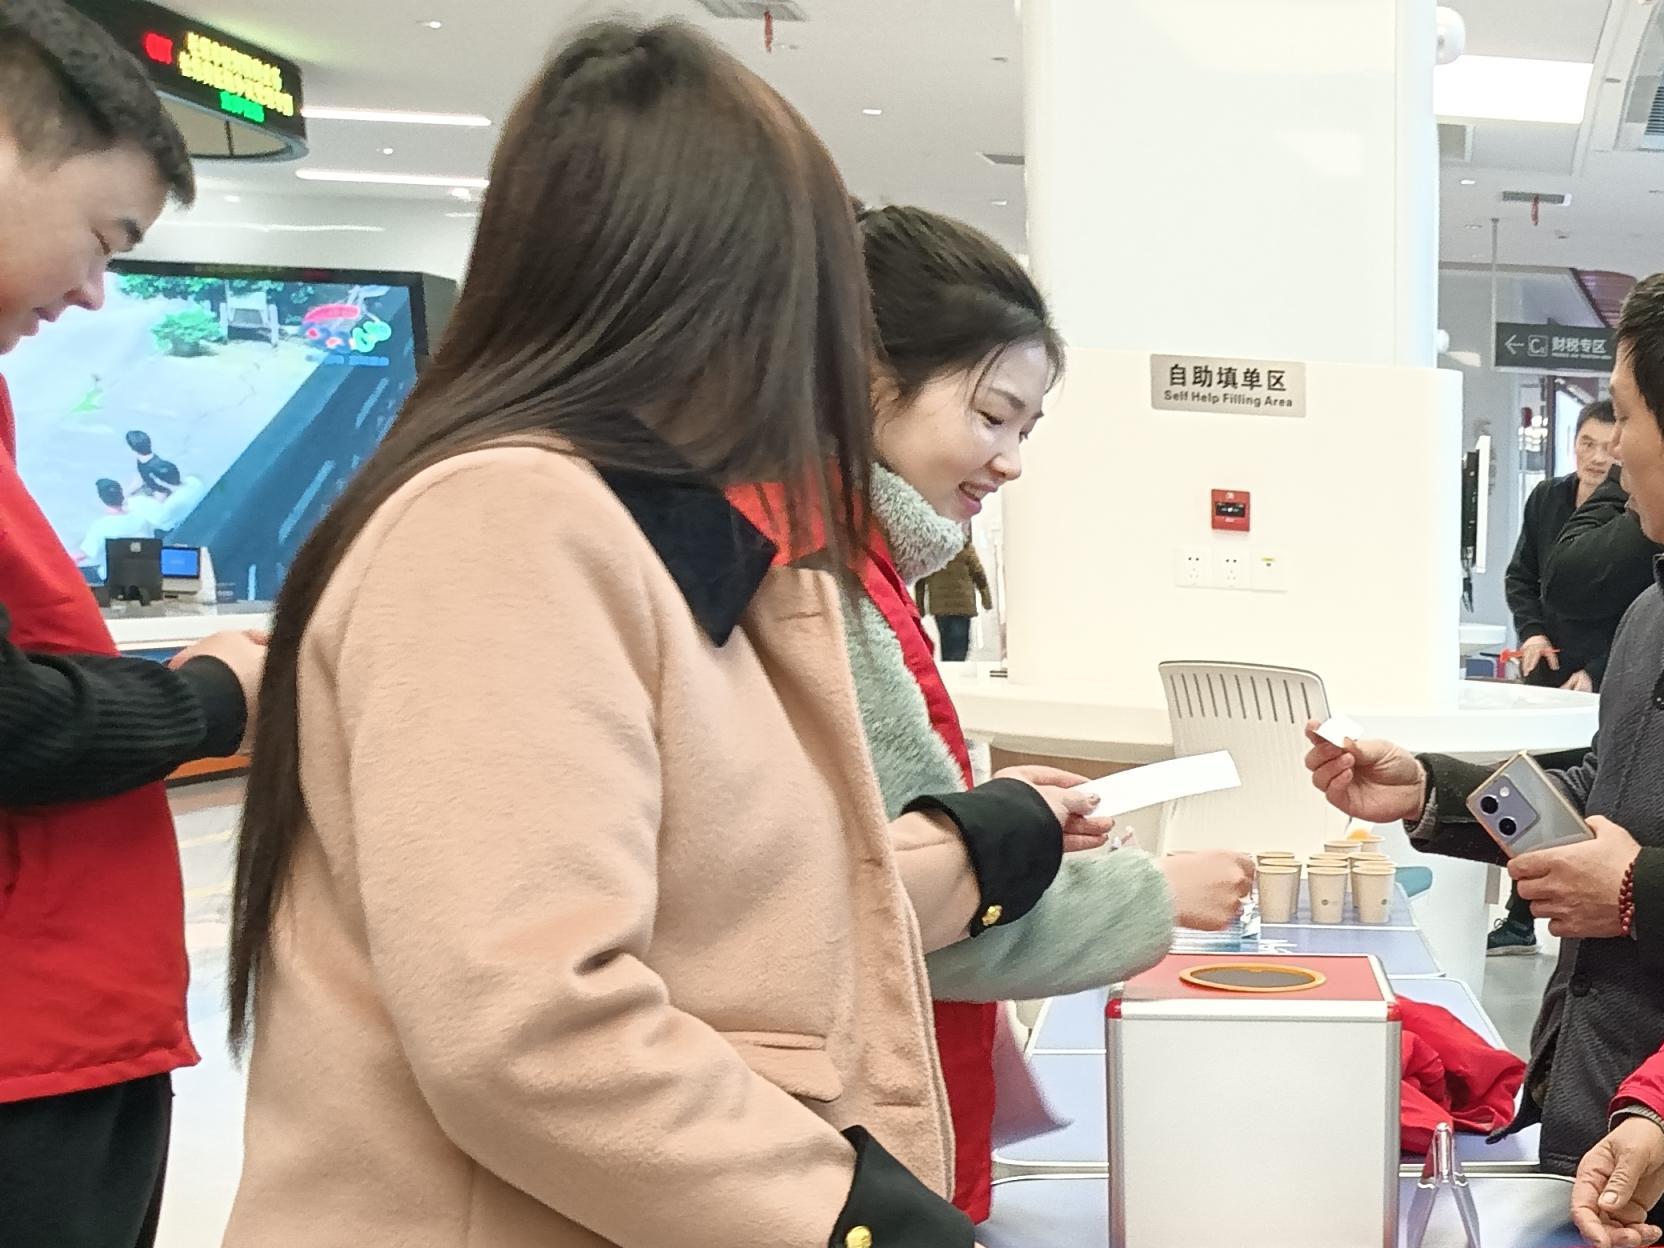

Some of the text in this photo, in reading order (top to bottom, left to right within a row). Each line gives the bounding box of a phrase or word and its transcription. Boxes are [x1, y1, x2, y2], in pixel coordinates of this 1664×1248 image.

[1551, 336, 1607, 354] 财税专区
[1169, 363, 1287, 392] 自助填单区
[1163, 389, 1293, 408] Self Help Filling Area
